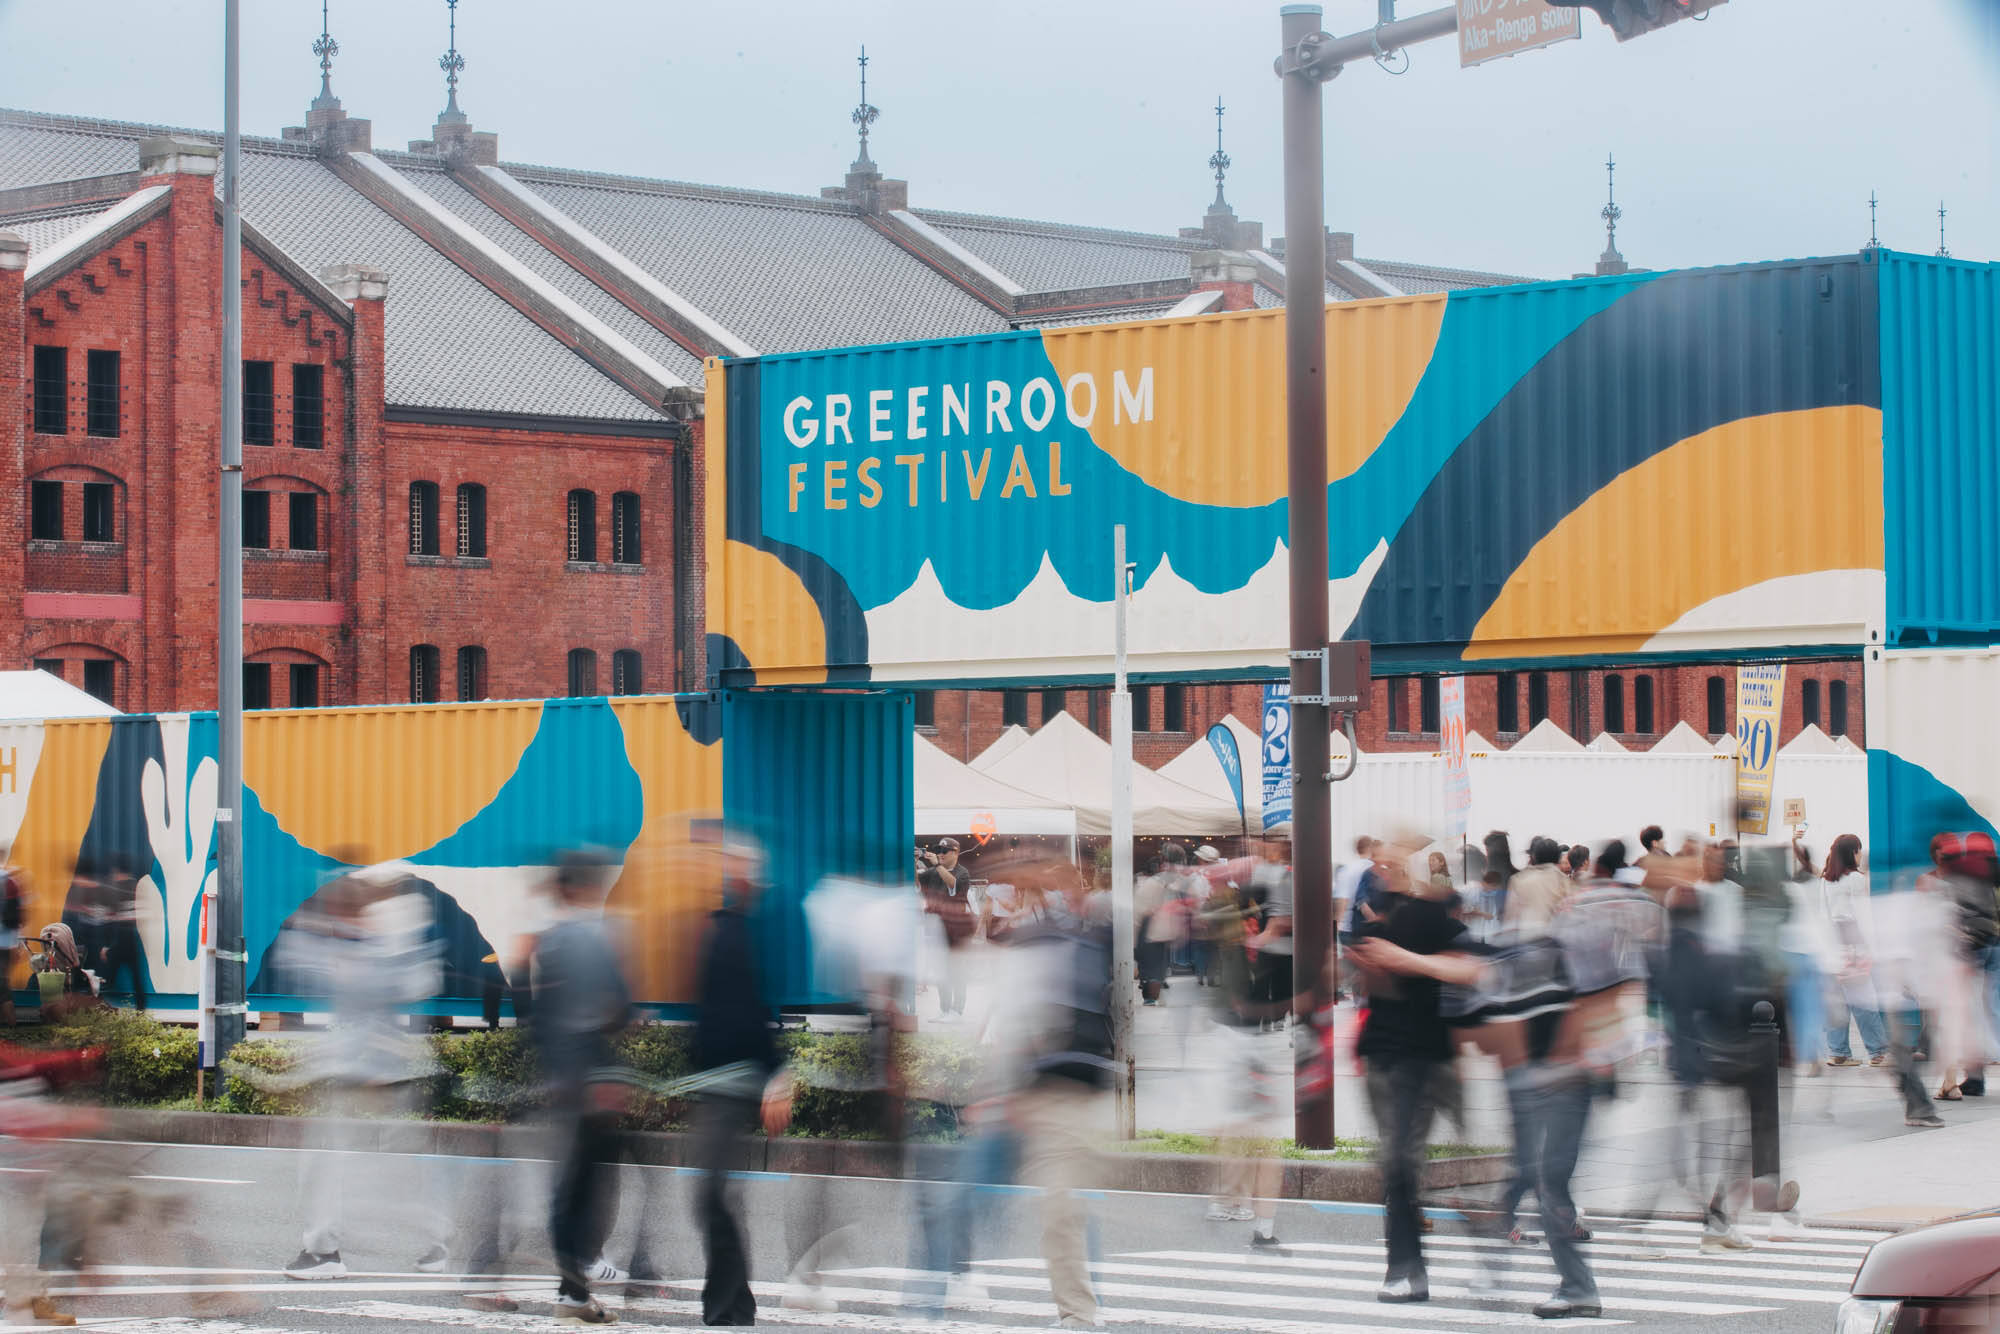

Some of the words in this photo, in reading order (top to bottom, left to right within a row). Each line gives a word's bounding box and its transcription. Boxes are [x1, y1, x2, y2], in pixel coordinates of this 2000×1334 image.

[1465, 15, 1537, 51] Aka-Renga
[784, 367, 1153, 448] GREENROOM
[789, 442, 1071, 512] FESTIVAL
[1738, 717, 1773, 772] 20
